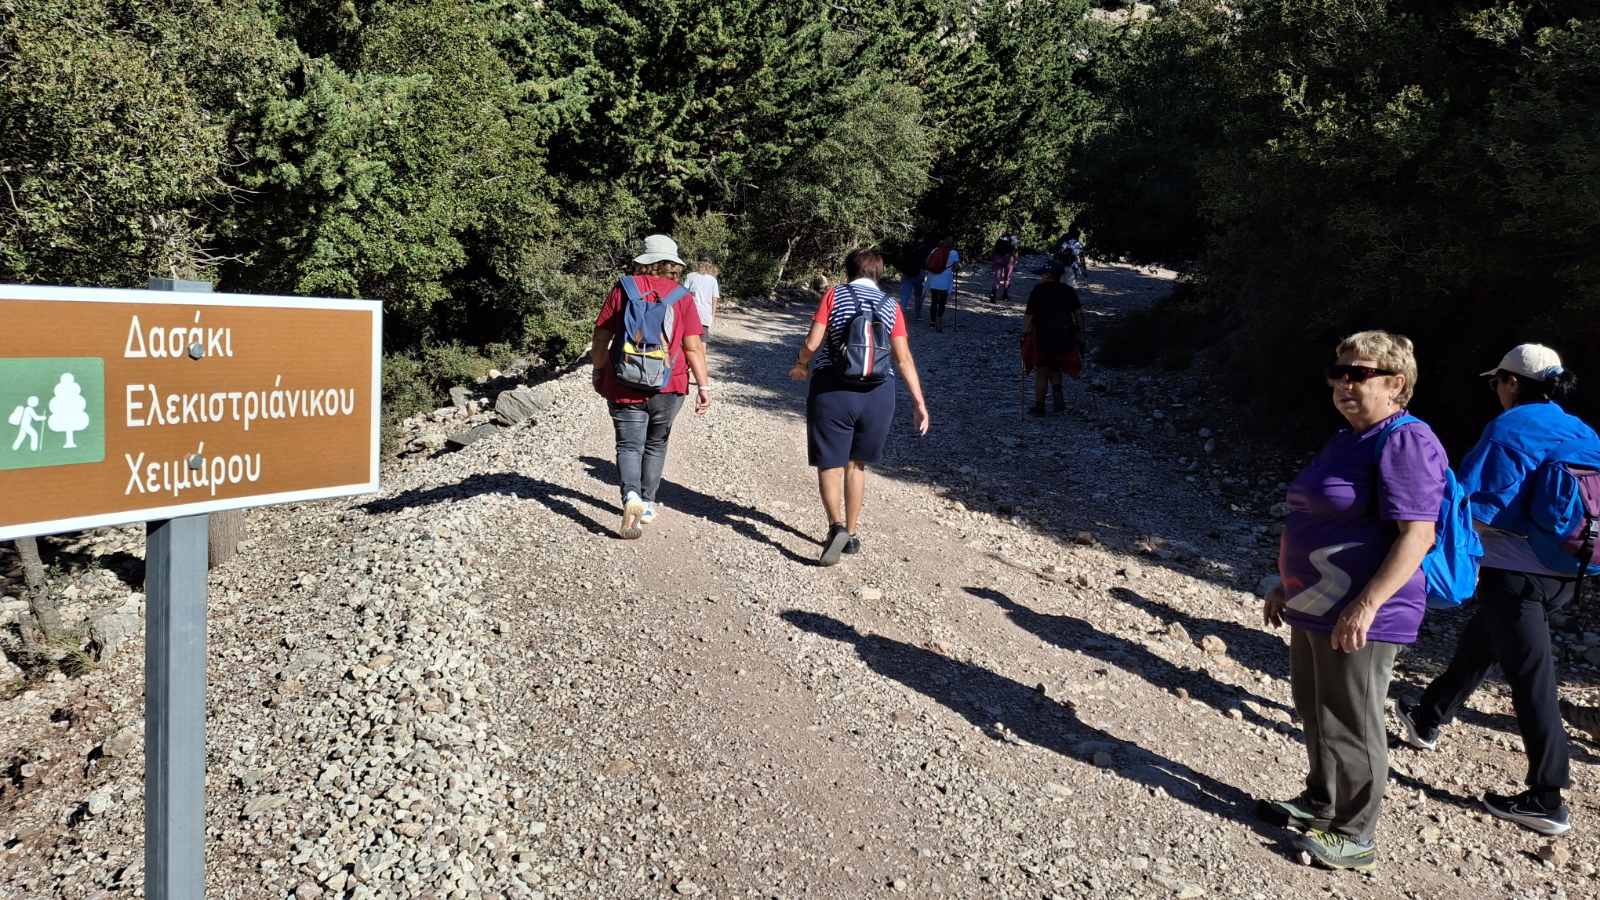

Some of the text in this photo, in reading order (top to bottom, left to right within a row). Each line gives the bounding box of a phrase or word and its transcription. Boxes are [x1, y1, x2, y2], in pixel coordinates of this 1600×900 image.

[124, 310, 233, 358] Δασάκι
[126, 374, 355, 431] Ελεκιστριάνικου
[124, 441, 261, 497] Χειμάρου
